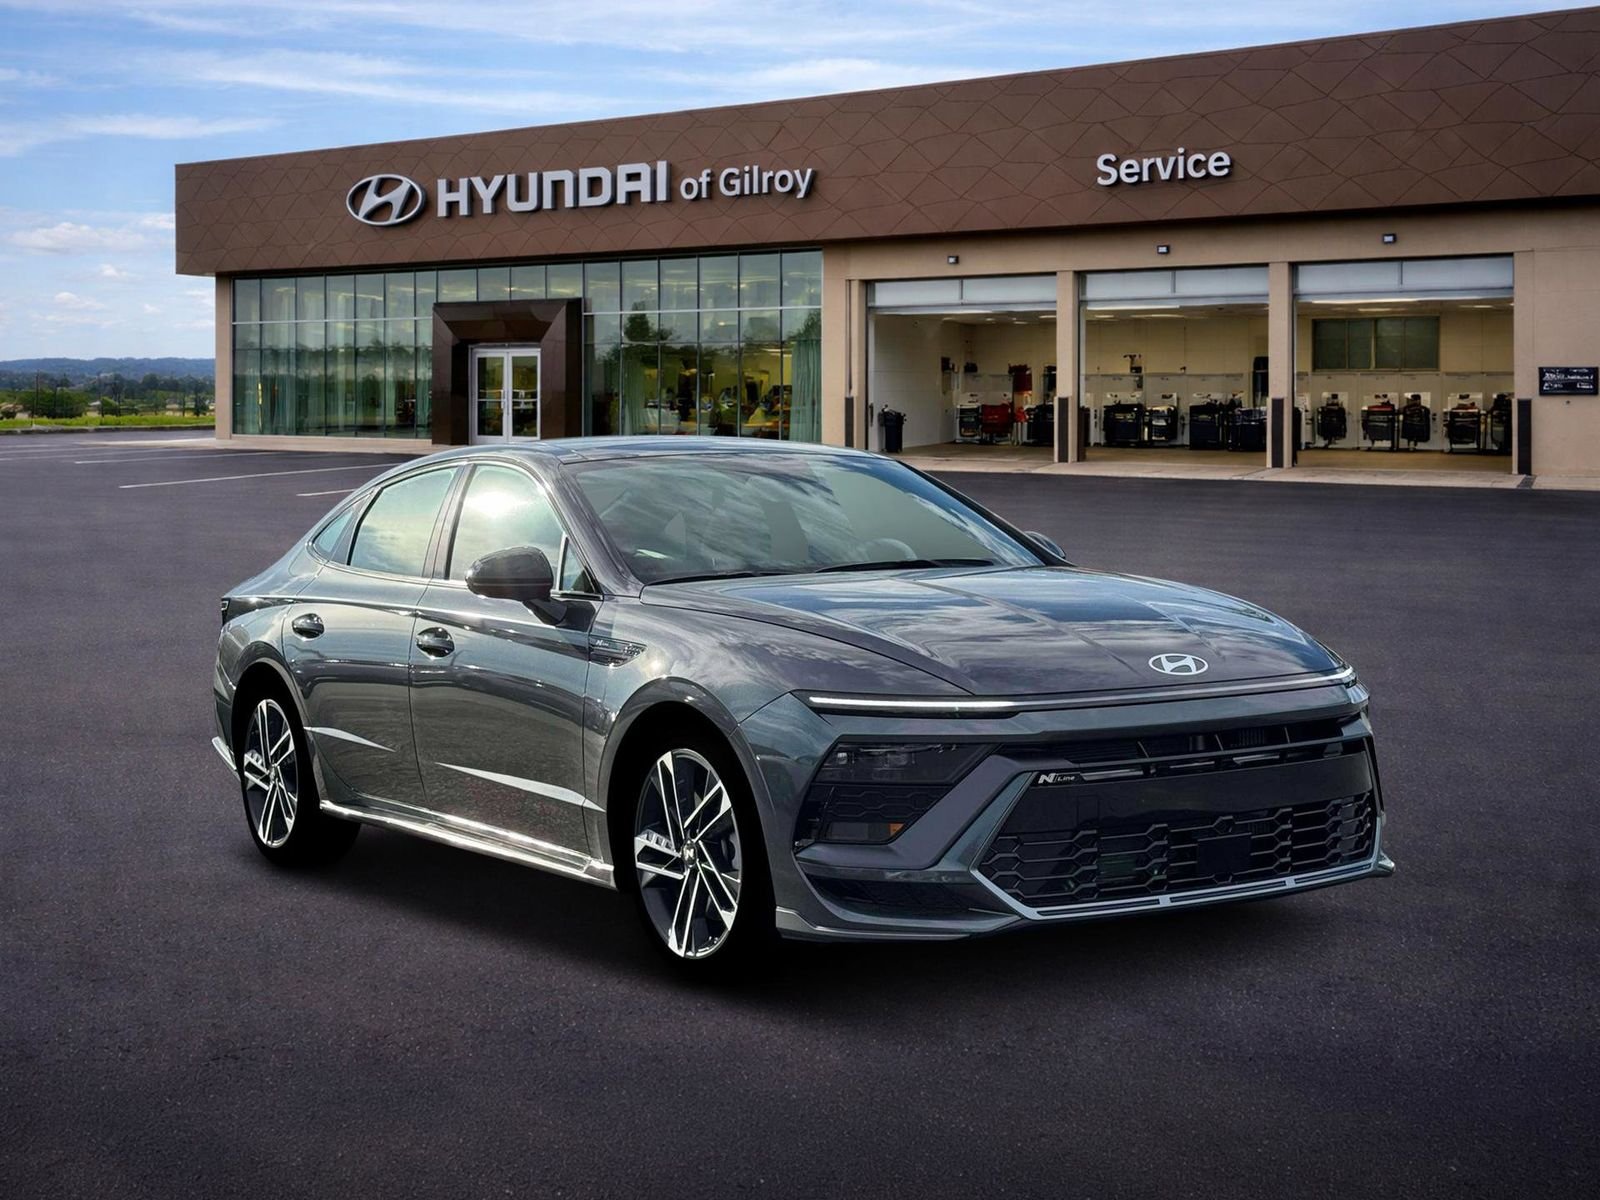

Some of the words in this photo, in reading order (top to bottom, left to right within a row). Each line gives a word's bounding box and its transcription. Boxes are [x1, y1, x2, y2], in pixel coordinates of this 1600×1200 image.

[1096, 147, 1231, 186] Service
[436, 160, 668, 217] HYUNDAI
[680, 168, 711, 200] of
[719, 165, 812, 198] Gilroy
[1038, 773, 1056, 784] N
